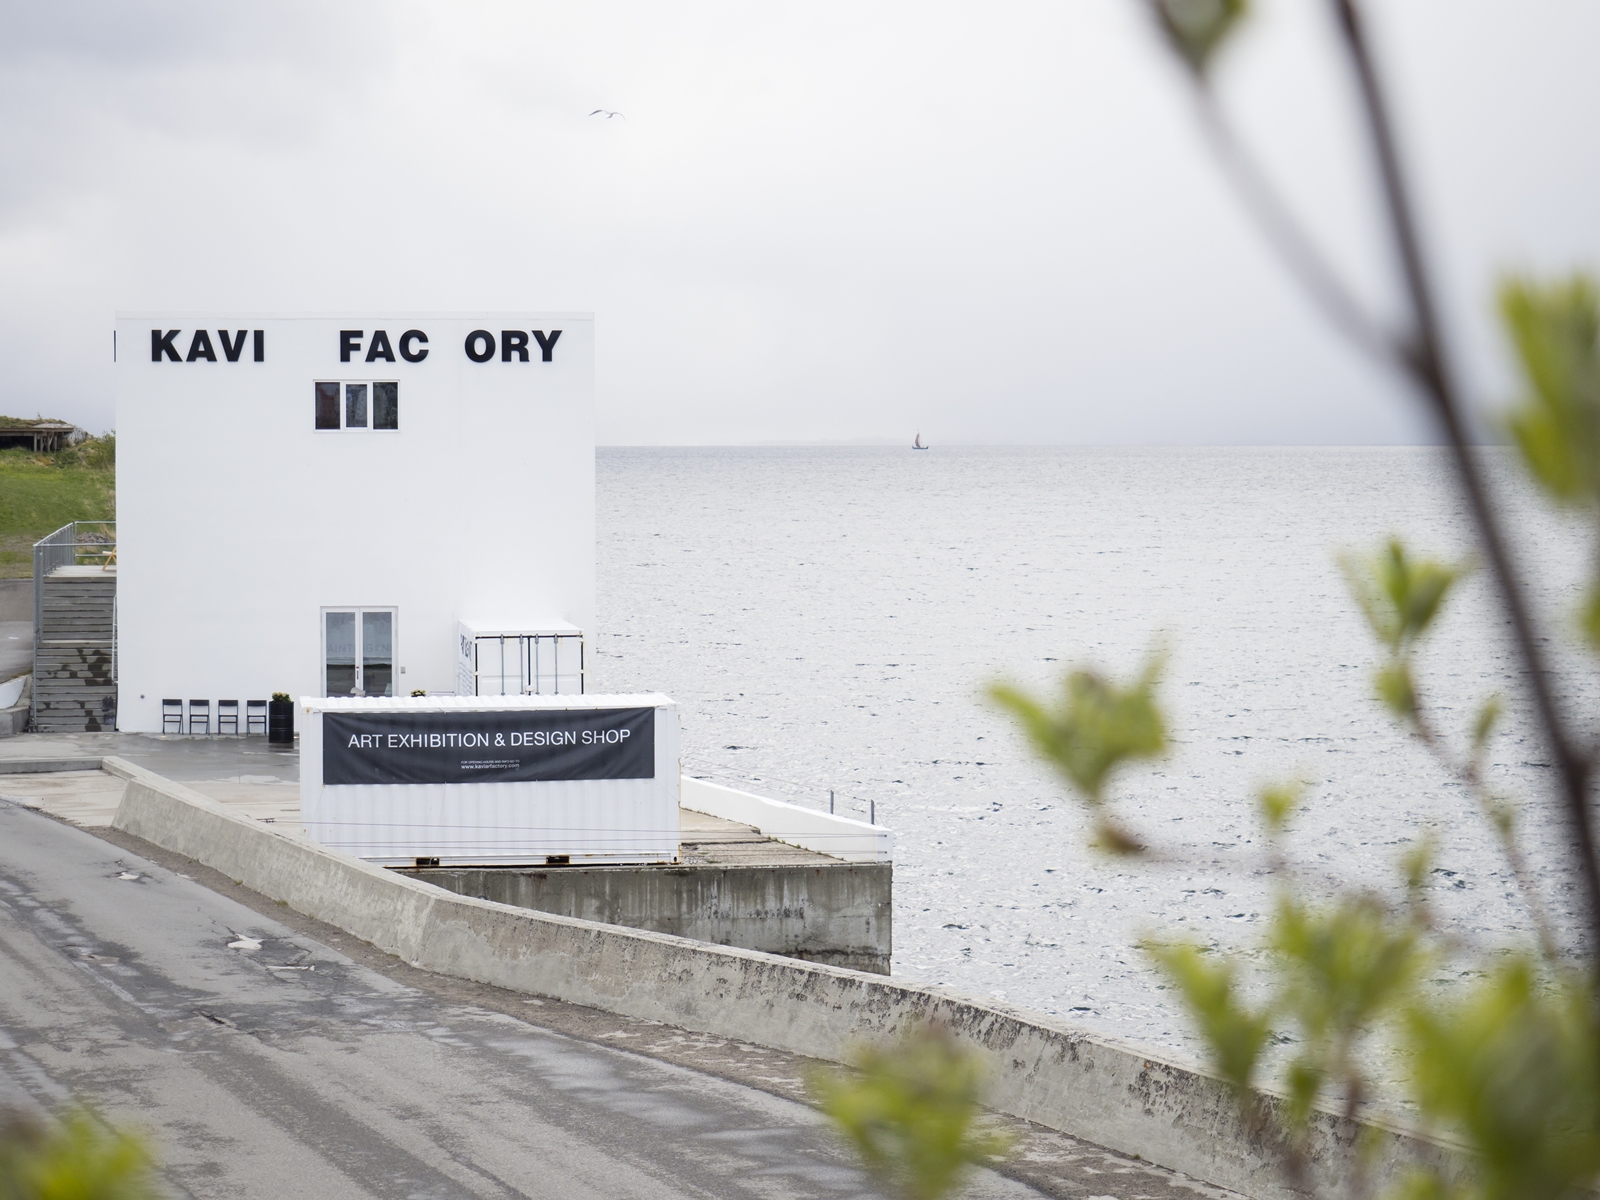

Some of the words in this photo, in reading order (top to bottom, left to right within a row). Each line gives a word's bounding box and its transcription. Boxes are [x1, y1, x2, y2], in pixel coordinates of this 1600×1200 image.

[152, 330, 265, 363] KAVI
[340, 330, 430, 363] FAC
[464, 330, 563, 363] ORY
[348, 734, 383, 748] ART
[388, 732, 489, 748] EXHIBITION
[494, 732, 507, 747] &
[510, 731, 577, 747] DESIGN
[581, 729, 631, 745] SHOP
